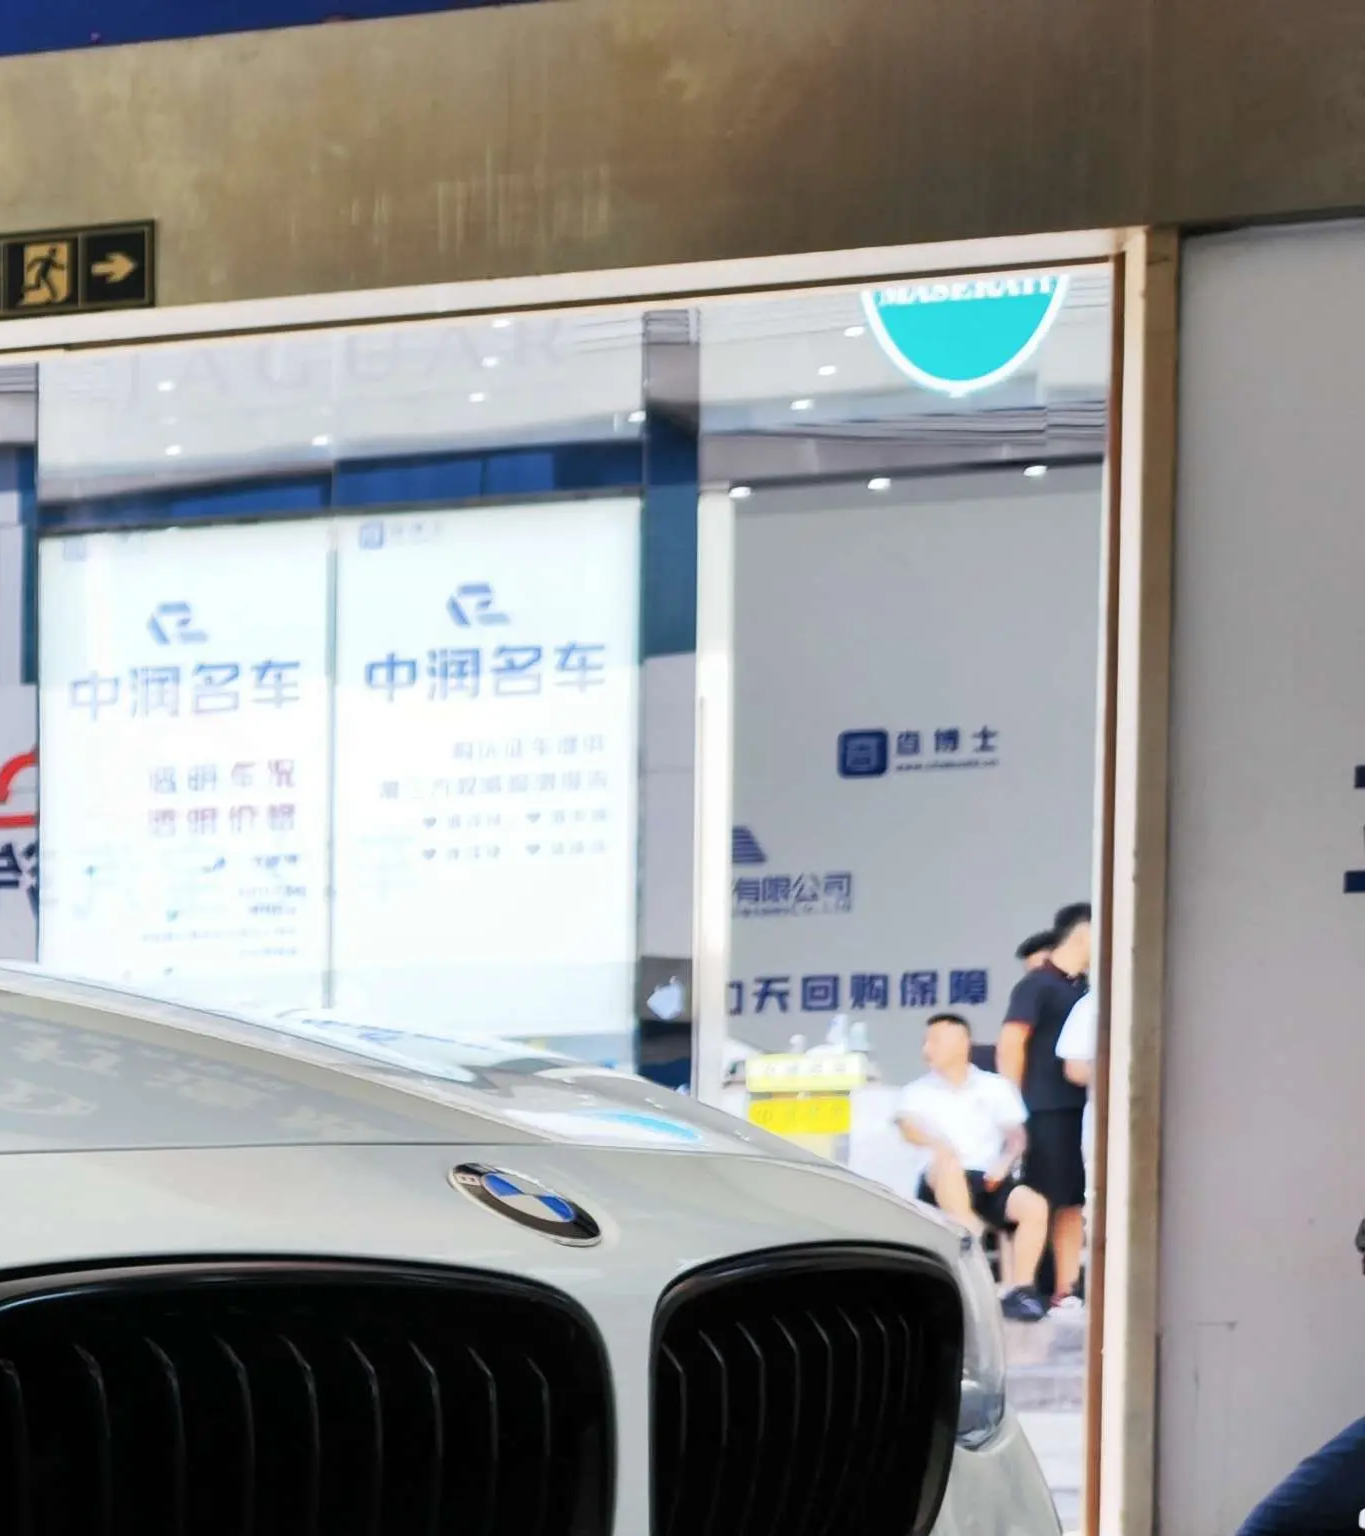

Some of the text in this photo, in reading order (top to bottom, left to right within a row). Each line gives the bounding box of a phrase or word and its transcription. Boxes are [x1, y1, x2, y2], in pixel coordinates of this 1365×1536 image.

[69, 657, 301, 722] 中润名车
[364, 642, 606, 702] 中润名车
